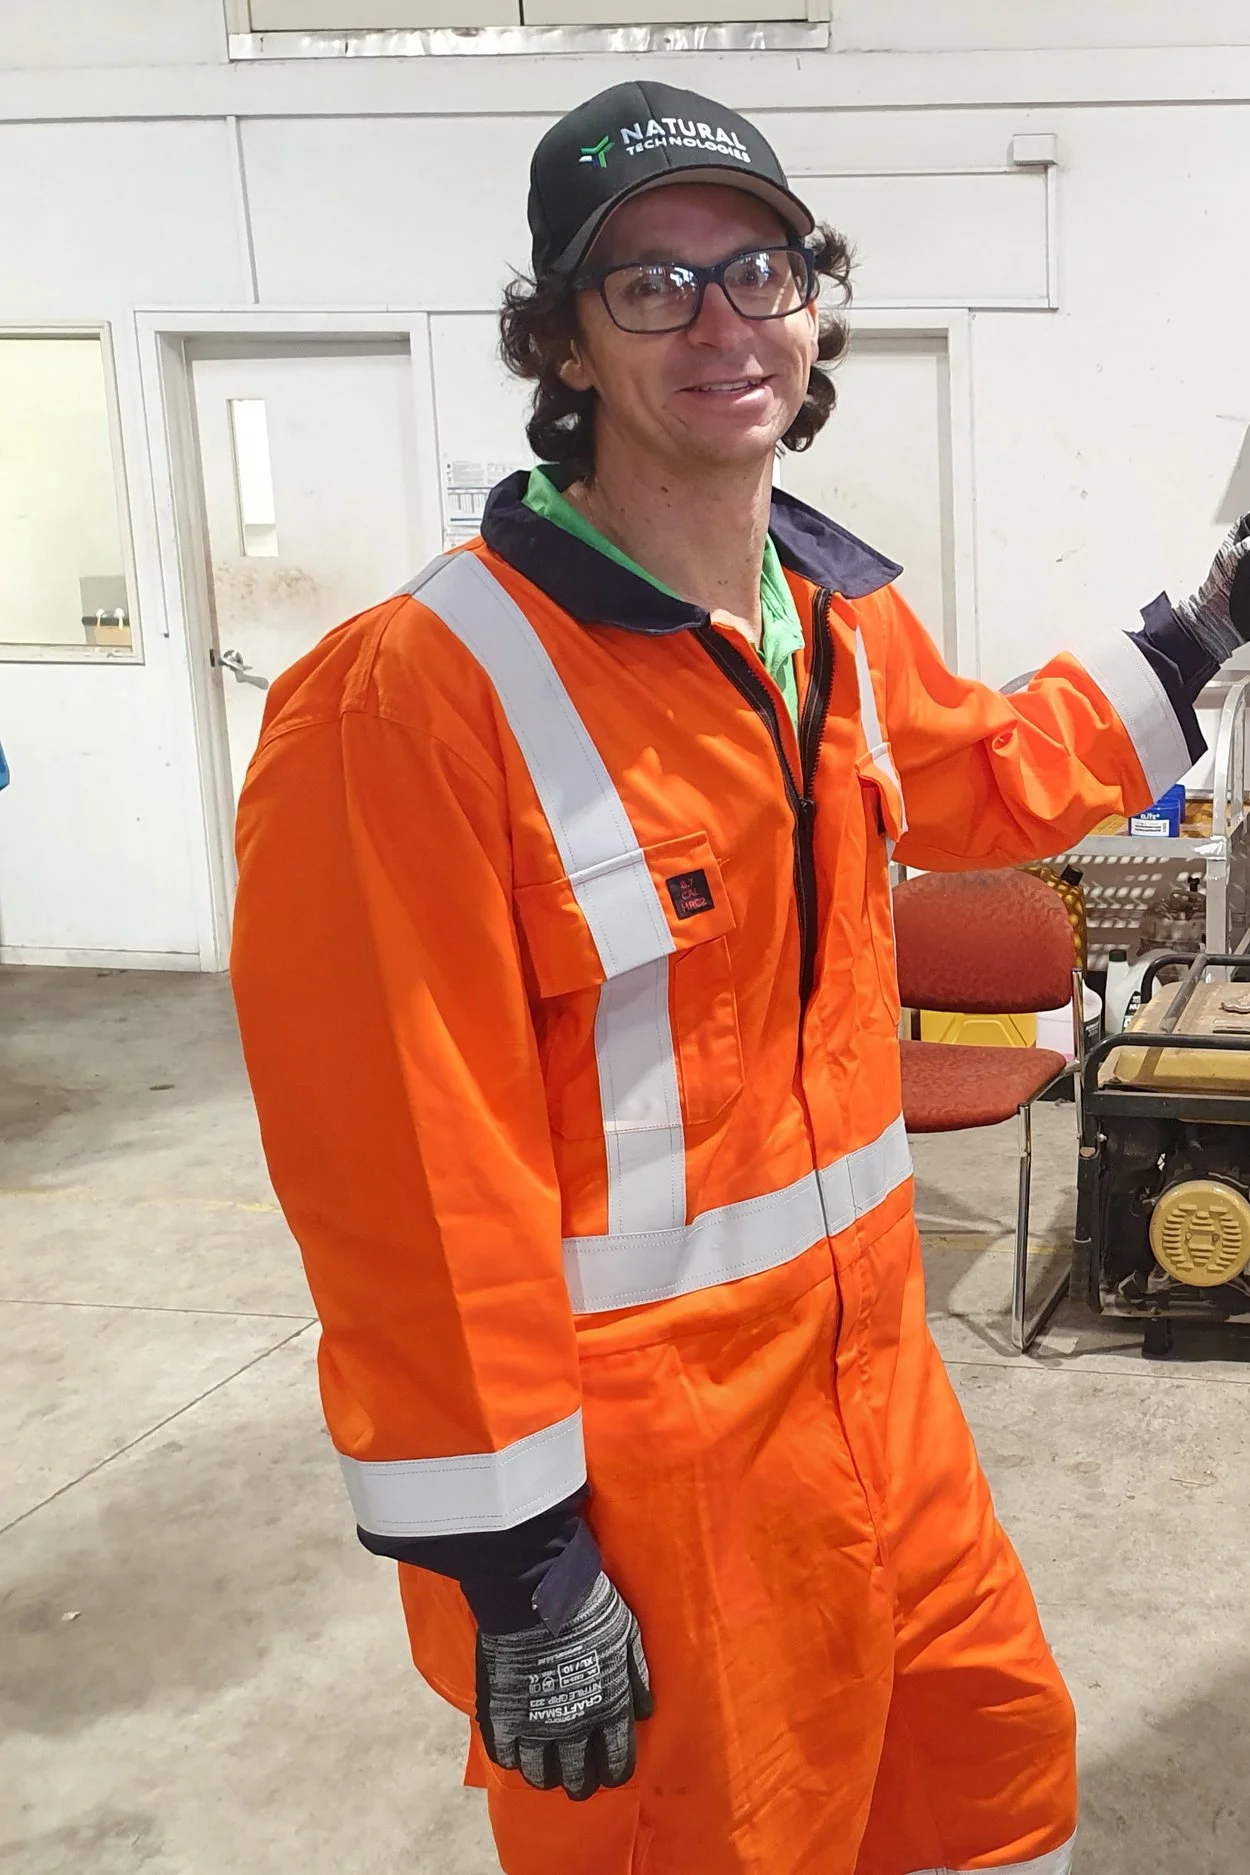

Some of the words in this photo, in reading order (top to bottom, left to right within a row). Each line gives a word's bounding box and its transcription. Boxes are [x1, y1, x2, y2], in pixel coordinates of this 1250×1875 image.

[620, 118, 747, 151] NATURAL
[626, 136, 751, 163] TECHNOLOGIES
[563, 1664, 574, 1674] 10
[581, 1656, 593, 1668] XL
[568, 1680, 602, 1701] NITRILE
[529, 1698, 546, 1708] 323
[547, 1693, 568, 1705] GRIP
[529, 1694, 603, 1721] CRAFTSMAN
